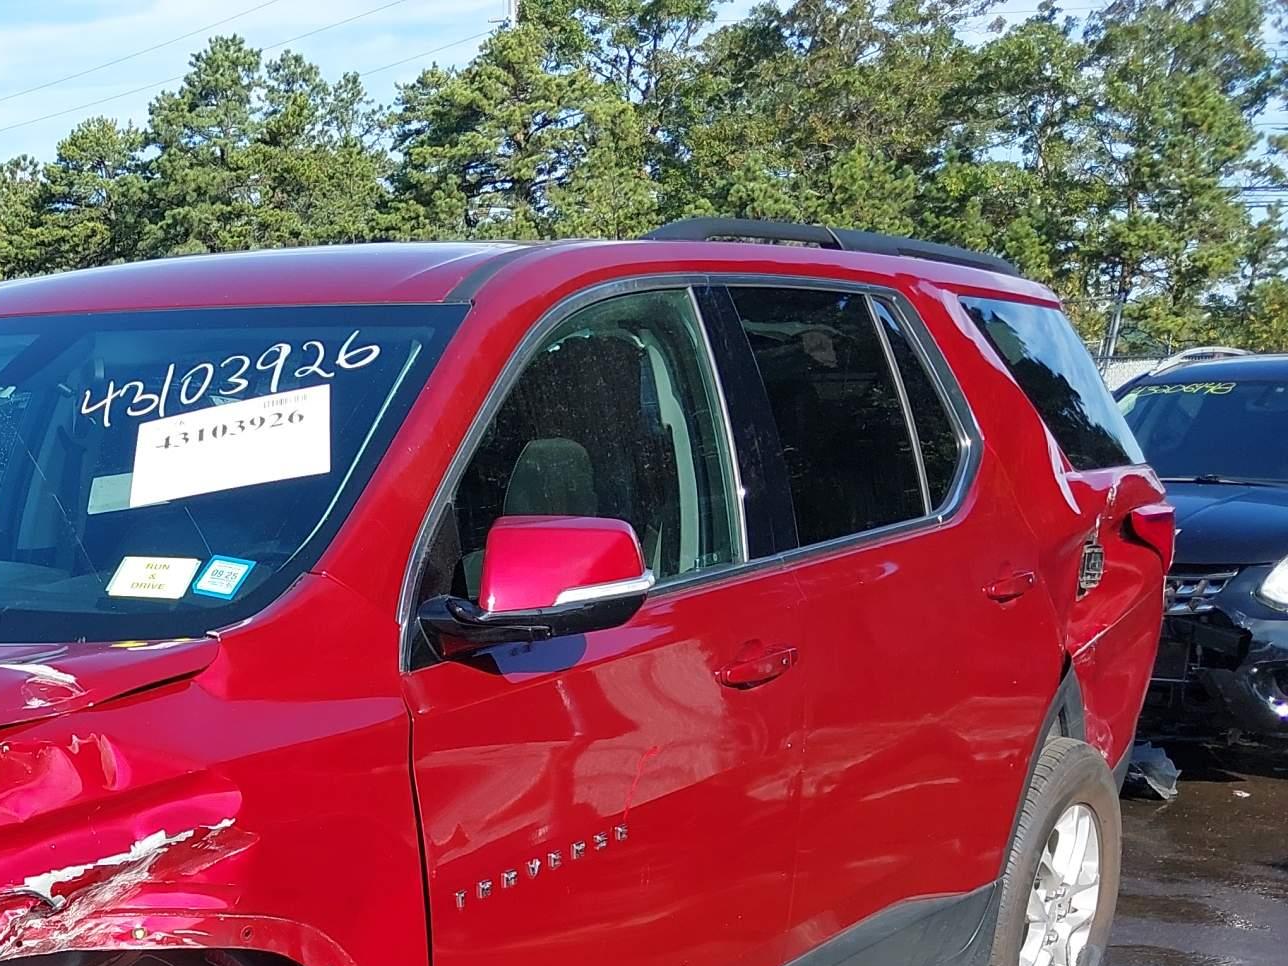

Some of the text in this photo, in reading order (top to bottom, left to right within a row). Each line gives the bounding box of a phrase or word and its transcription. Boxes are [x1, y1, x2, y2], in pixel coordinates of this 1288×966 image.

[80, 330, 381, 428] 43103926
[155, 409, 305, 449] 43103926
[130, 581, 168, 590] DRIVE
[145, 563, 171, 571] RUN
[453, 823, 629, 911] TRAVERSE
